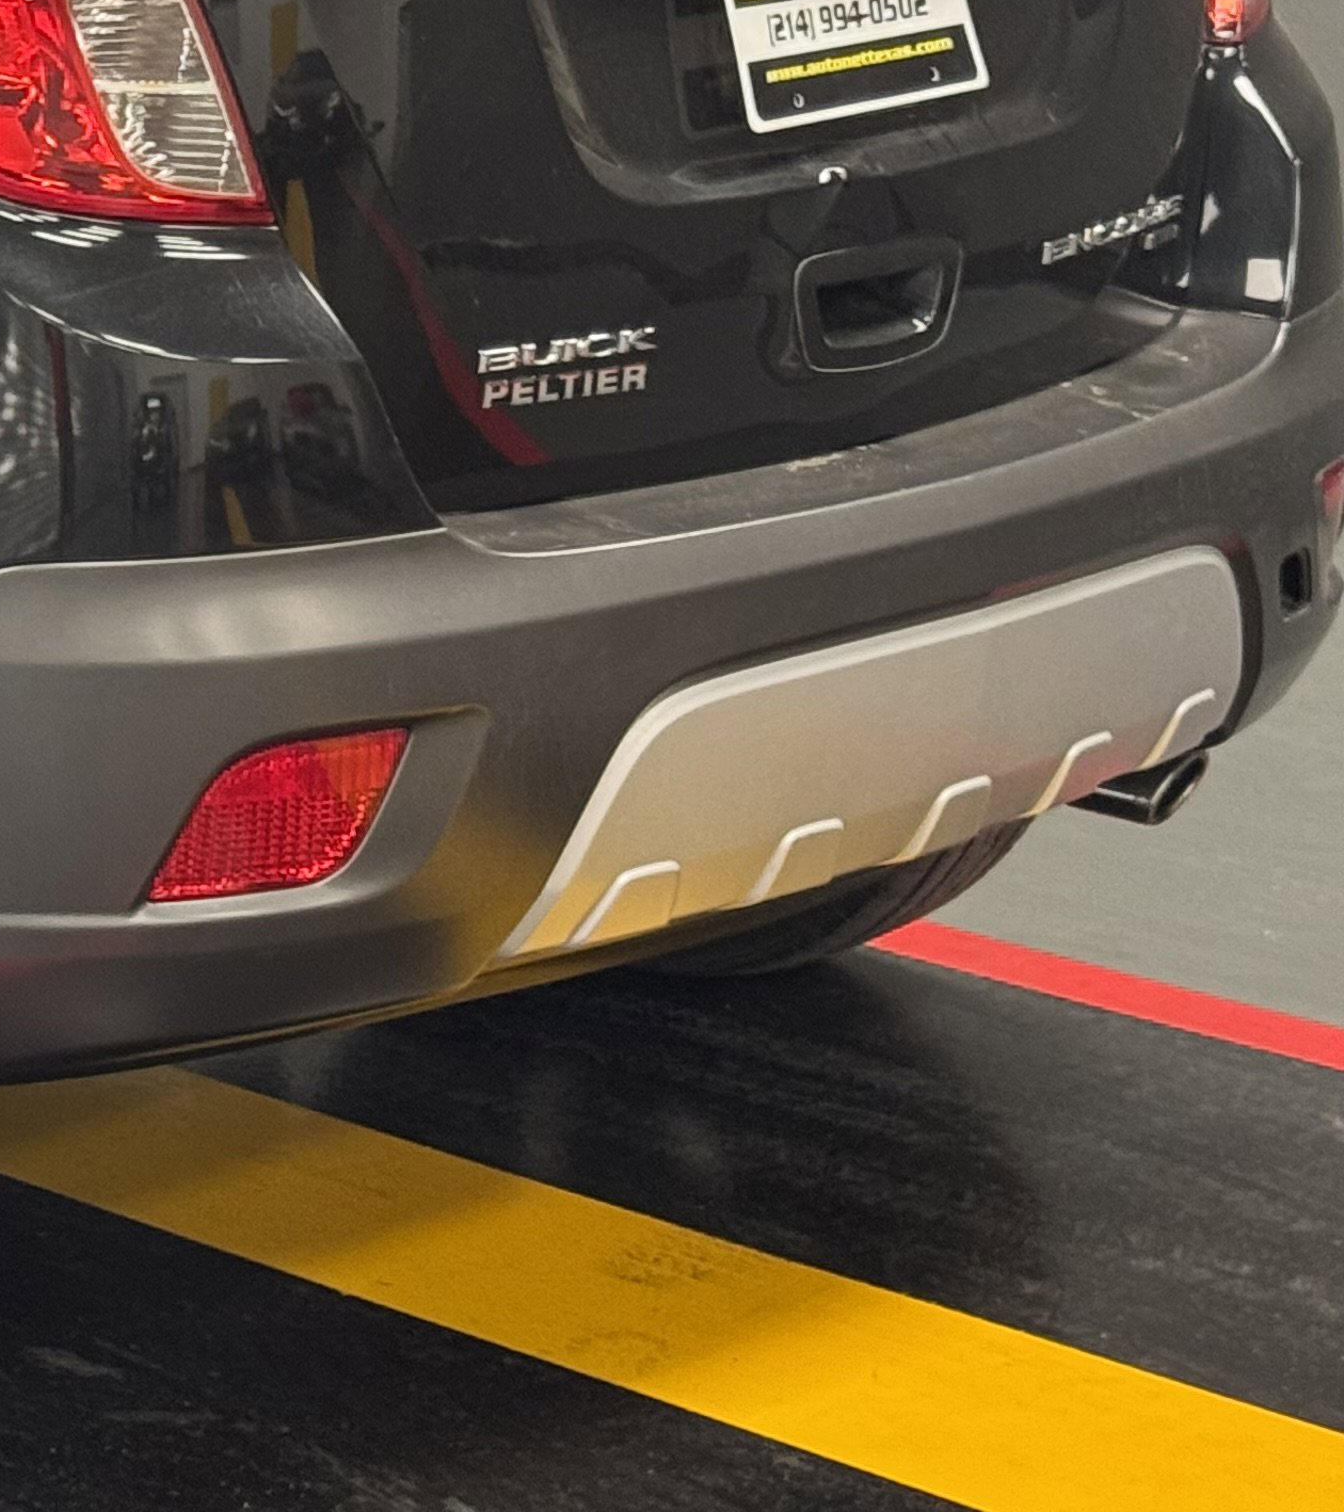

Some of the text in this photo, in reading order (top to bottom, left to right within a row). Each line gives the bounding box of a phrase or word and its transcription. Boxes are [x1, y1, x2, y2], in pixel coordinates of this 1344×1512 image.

[767, 7, 816, 47] (214)
[766, 37, 954, 84] www.autonettexas.com
[477, 326, 658, 374] BUICK
[482, 362, 648, 409] PELTIER
